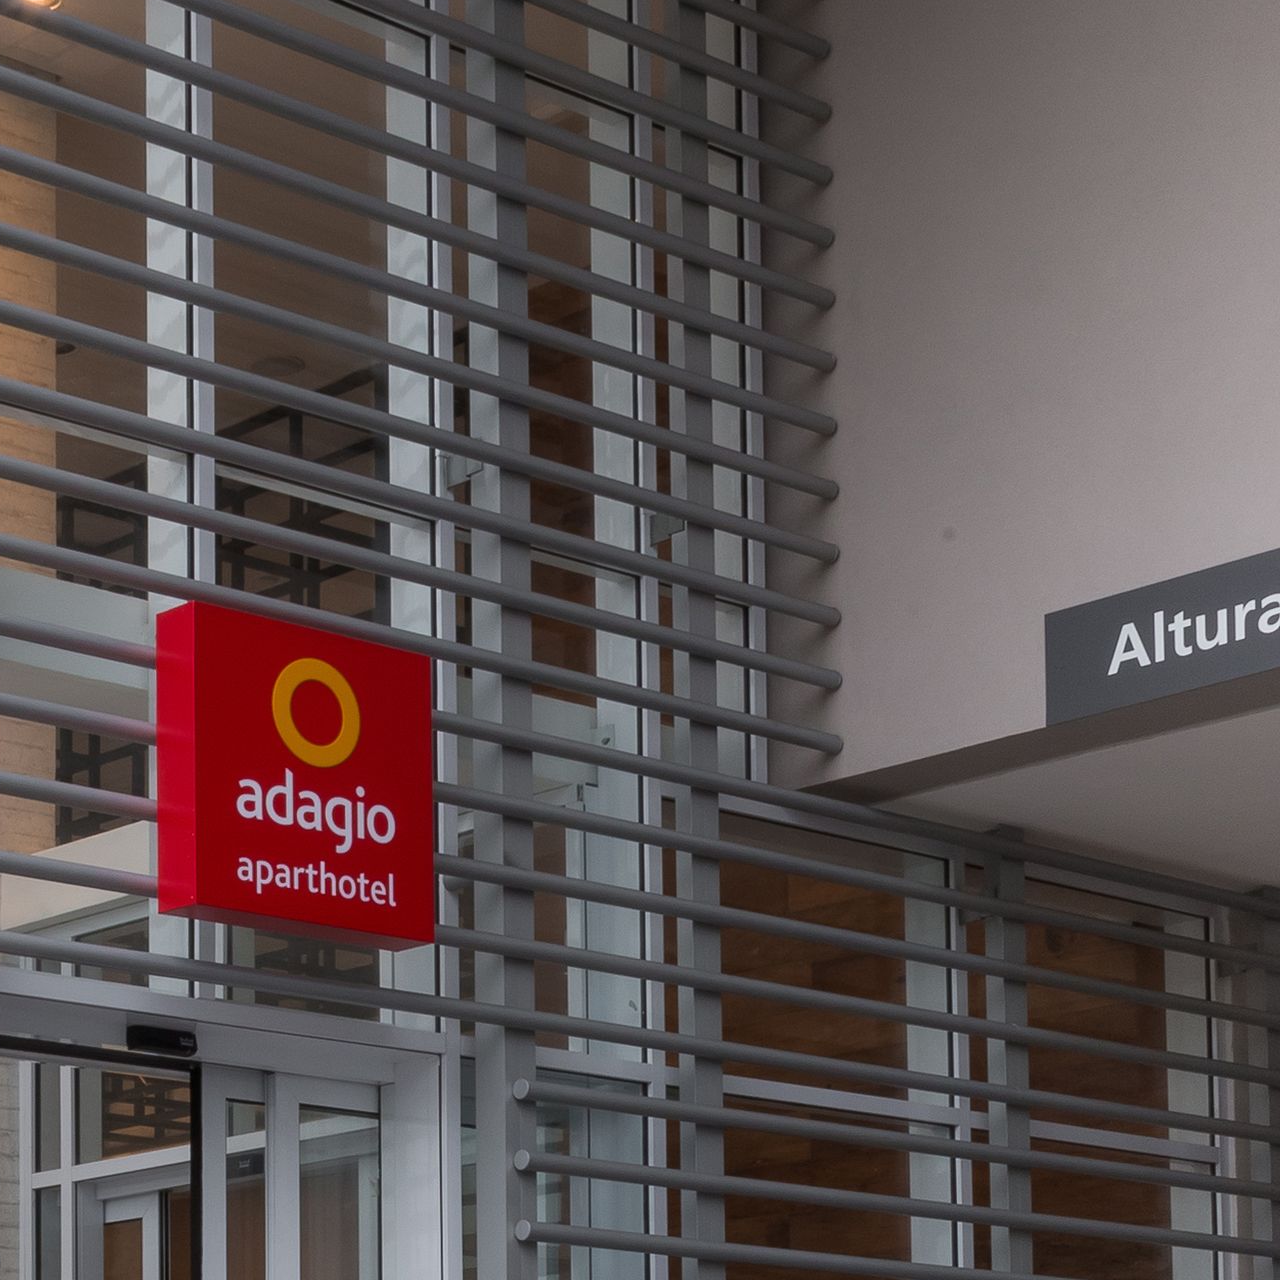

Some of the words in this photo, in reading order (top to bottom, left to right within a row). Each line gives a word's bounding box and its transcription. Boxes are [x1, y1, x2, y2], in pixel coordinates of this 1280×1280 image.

[1107, 593, 1280, 676] Altura
[236, 767, 396, 854] adagio
[237, 856, 397, 908] aparthotel
